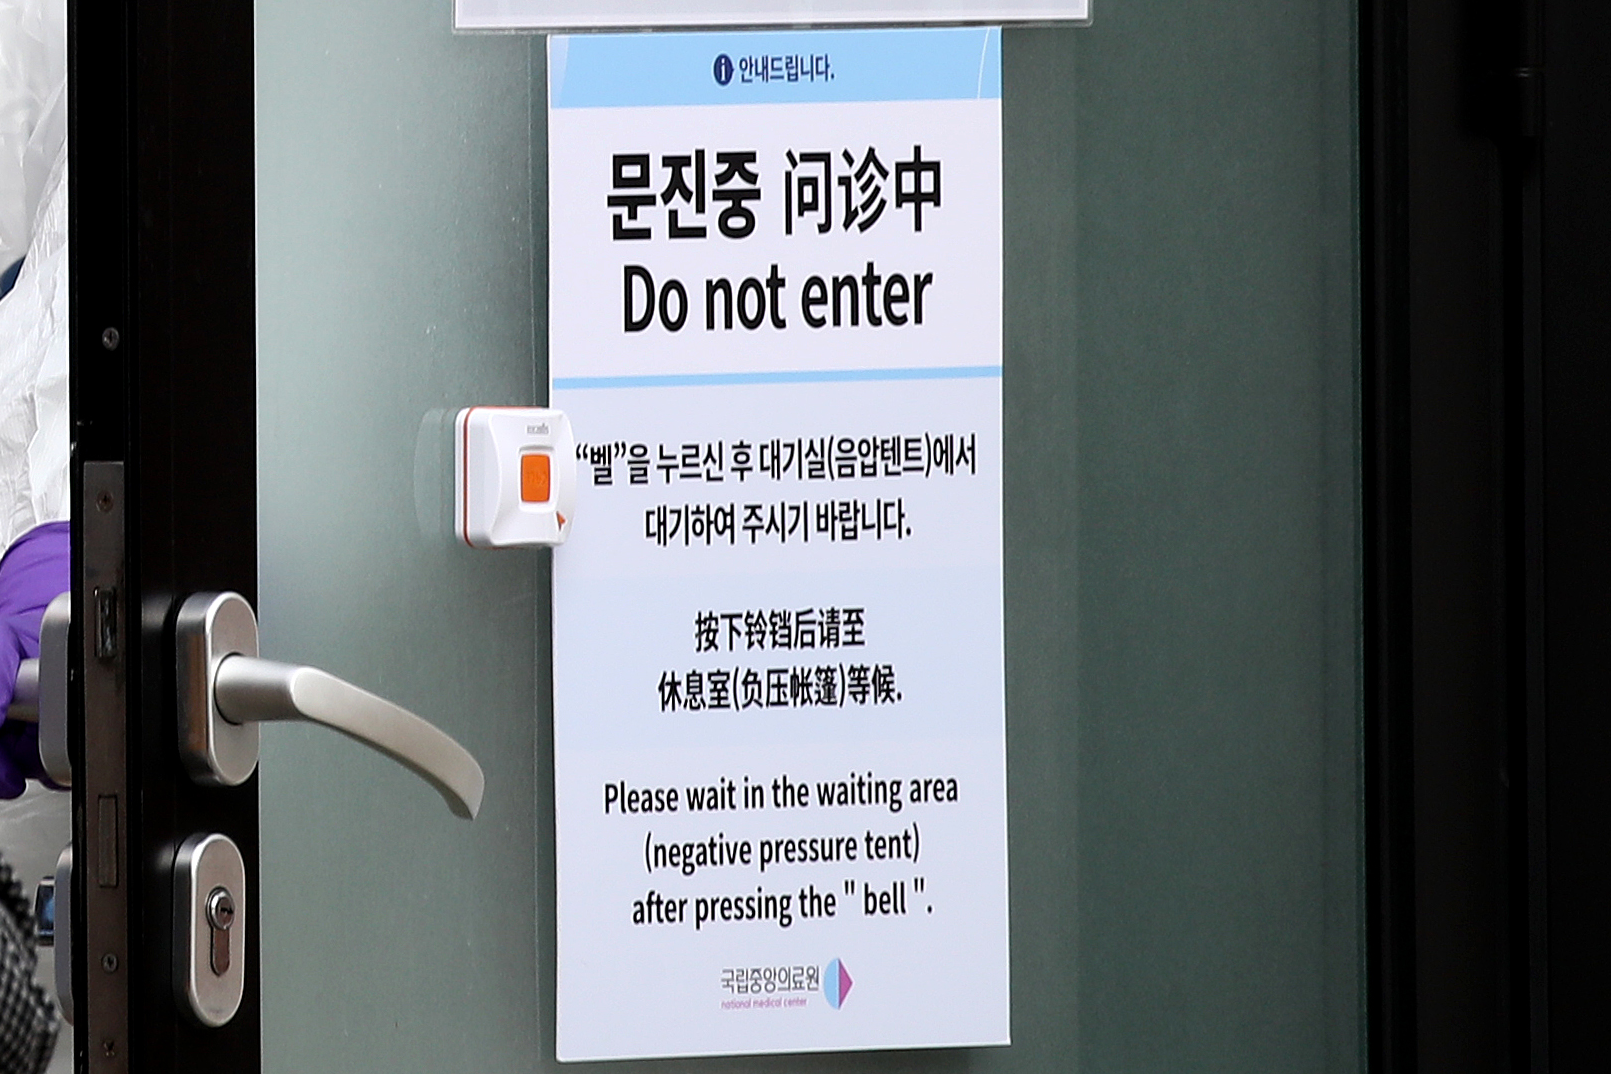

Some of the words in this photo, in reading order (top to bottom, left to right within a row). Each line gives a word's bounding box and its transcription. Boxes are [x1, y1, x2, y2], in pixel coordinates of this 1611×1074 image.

[738, 53, 835, 83] 안내드립니다.
[606, 148, 762, 241] 문진중
[784, 144, 942, 236] 问诊中
[623, 264, 689, 333] Do
[705, 263, 787, 331] not
[801, 261, 934, 329] enter
[656, 440, 724, 484] 누르신
[730, 440, 754, 482] 후
[759, 432, 976, 481] 대기실(음압텐트)에서
[645, 502, 735, 547] 대기하여
[742, 500, 809, 545] 주시기
[815, 497, 912, 542] 바랍니다.
[694, 606, 866, 653] 按下铃铛后请至
[604, 780, 679, 815] Please
[685, 776, 737, 811] wait
[743, 775, 764, 809] in
[771, 774, 810, 809] the
[816, 771, 903, 814] waiting
[909, 778, 958, 804] area
[645, 831, 752, 876] (negative
[759, 836, 858, 873] pressure
[864, 821, 920, 863] tent)
[632, 890, 688, 925] after
[695, 886, 793, 931] pressing
[798, 884, 837, 918] the
[721, 965, 820, 994] 국립중앙의료원
[721, 998, 751, 1009] national
[753, 996, 782, 1008] medical
[784, 996, 807, 1007] center
